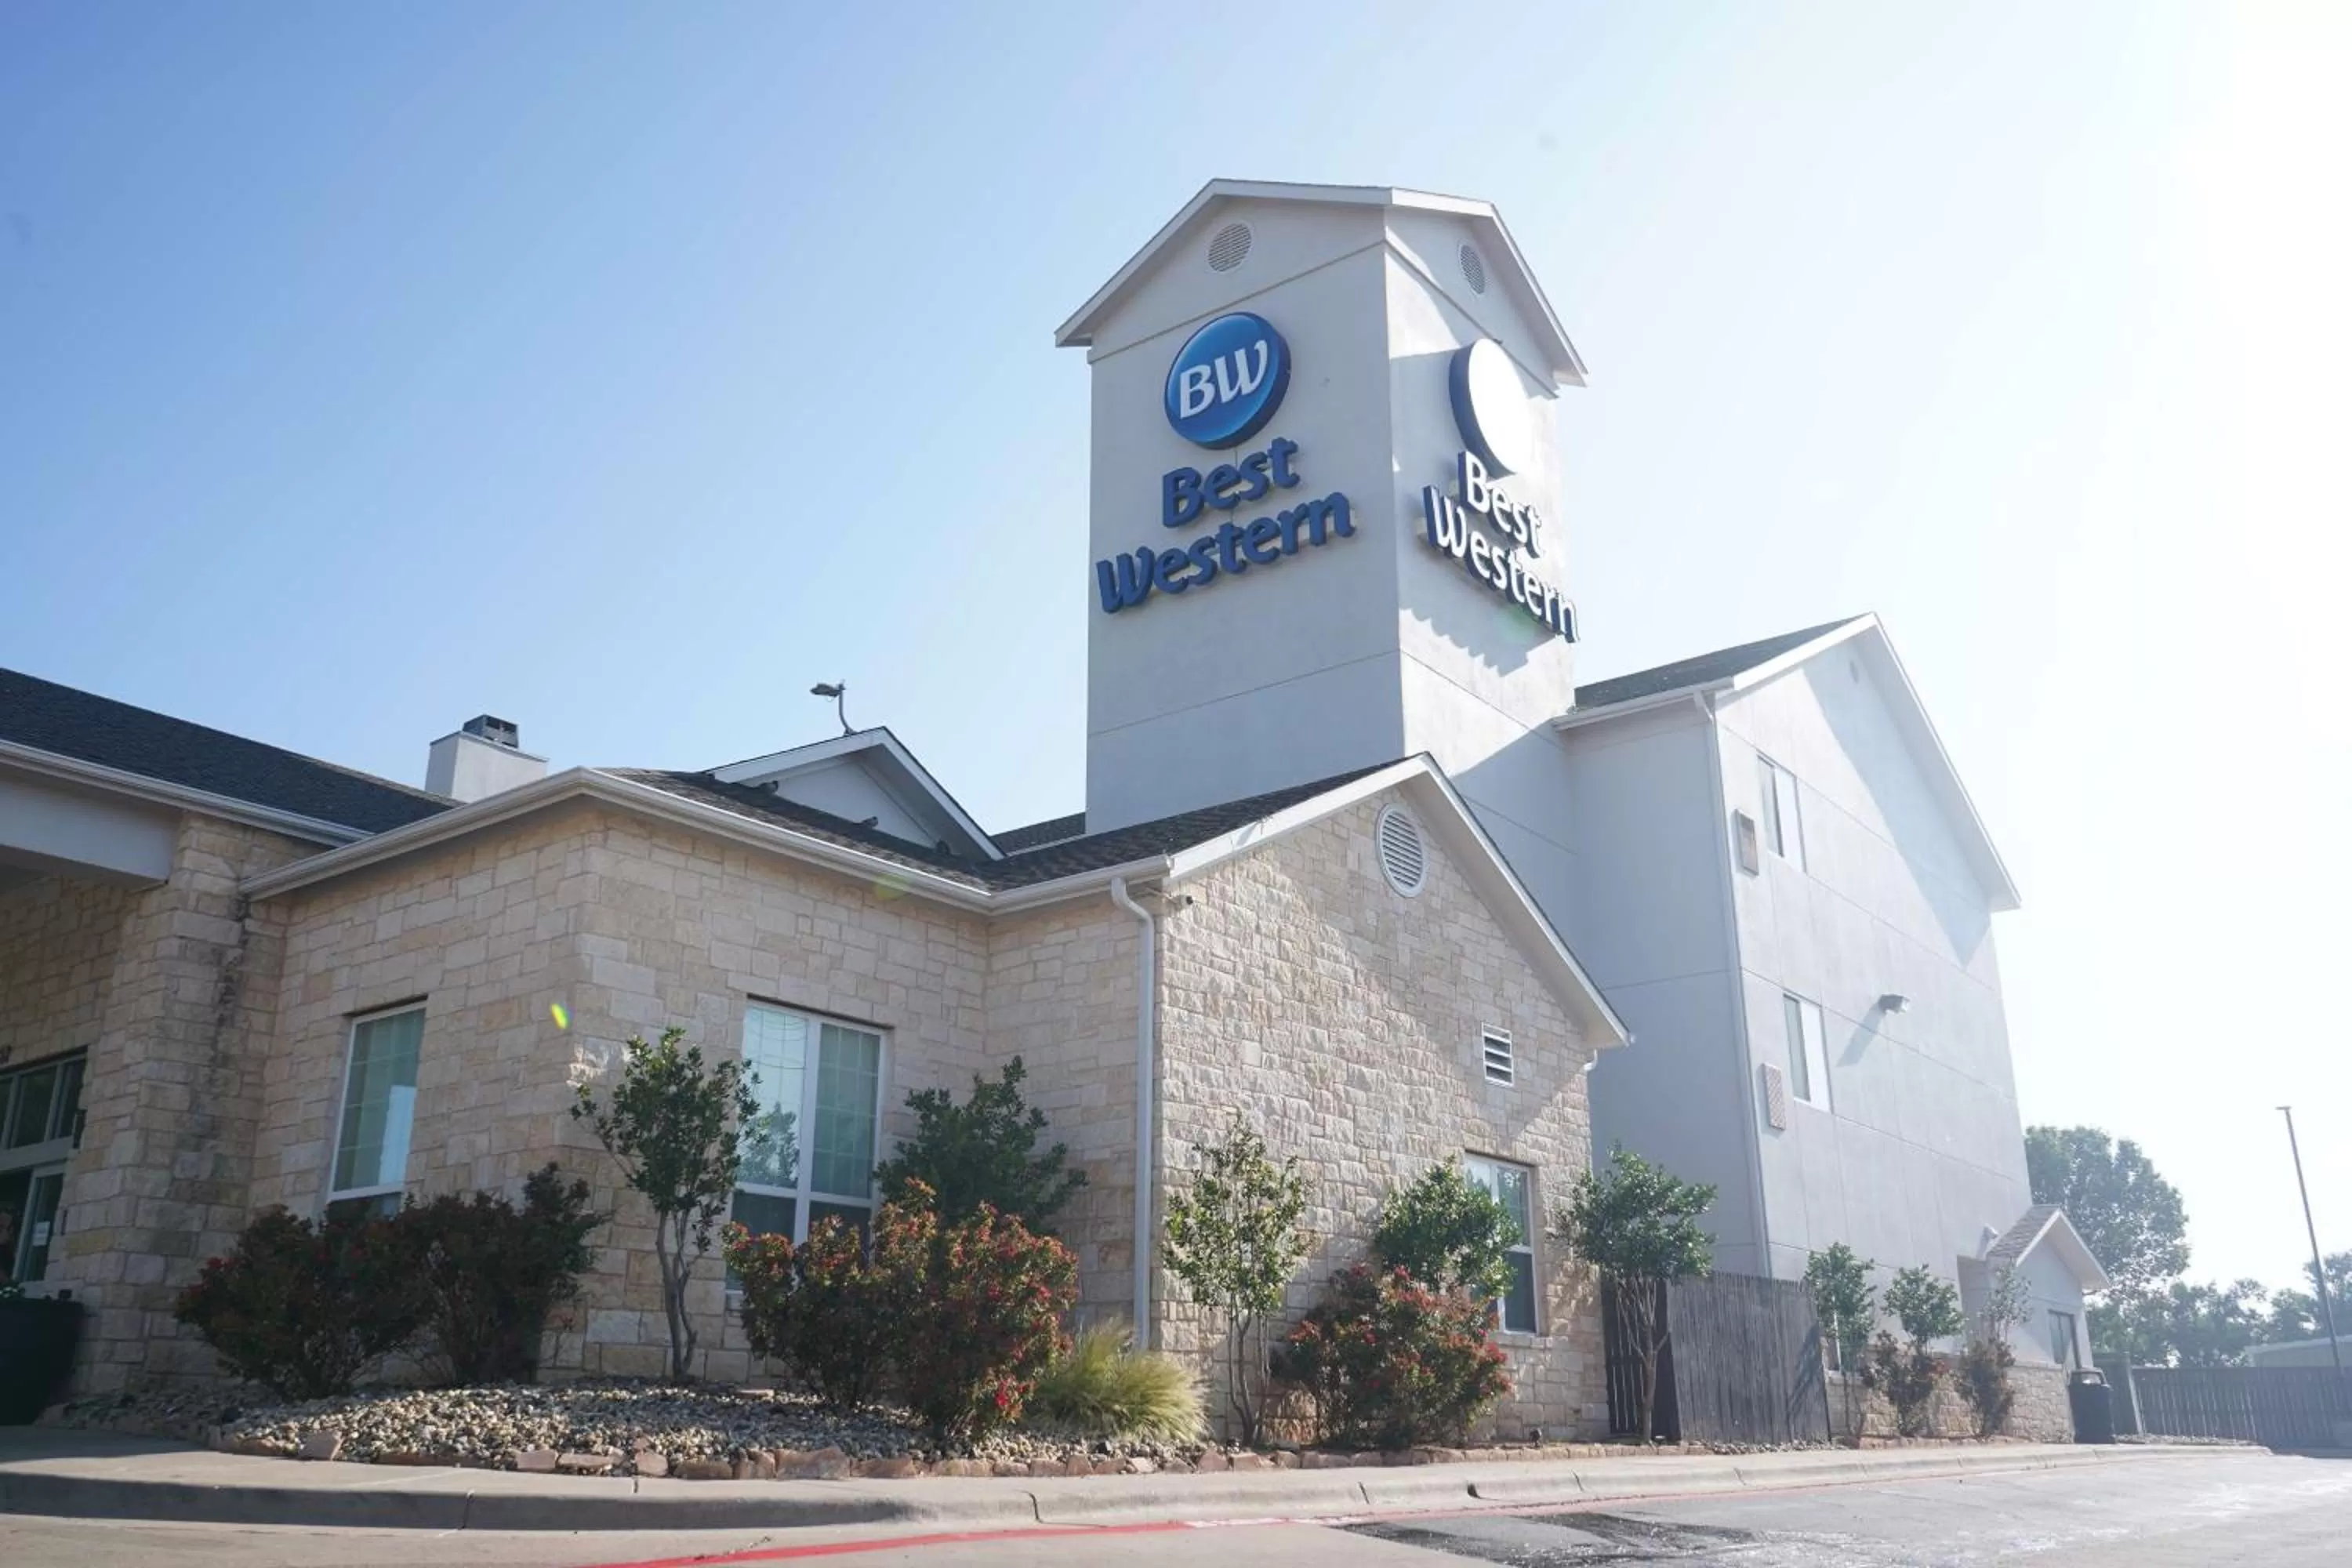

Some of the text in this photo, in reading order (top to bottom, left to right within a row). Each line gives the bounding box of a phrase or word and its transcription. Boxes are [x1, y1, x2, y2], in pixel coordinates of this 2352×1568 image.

[1180, 339, 1269, 419] BW
[1162, 436, 1301, 528] Best
[1458, 450, 1544, 559] Best
[1095, 492, 1356, 614] Western
[1423, 485, 1580, 644] Western
